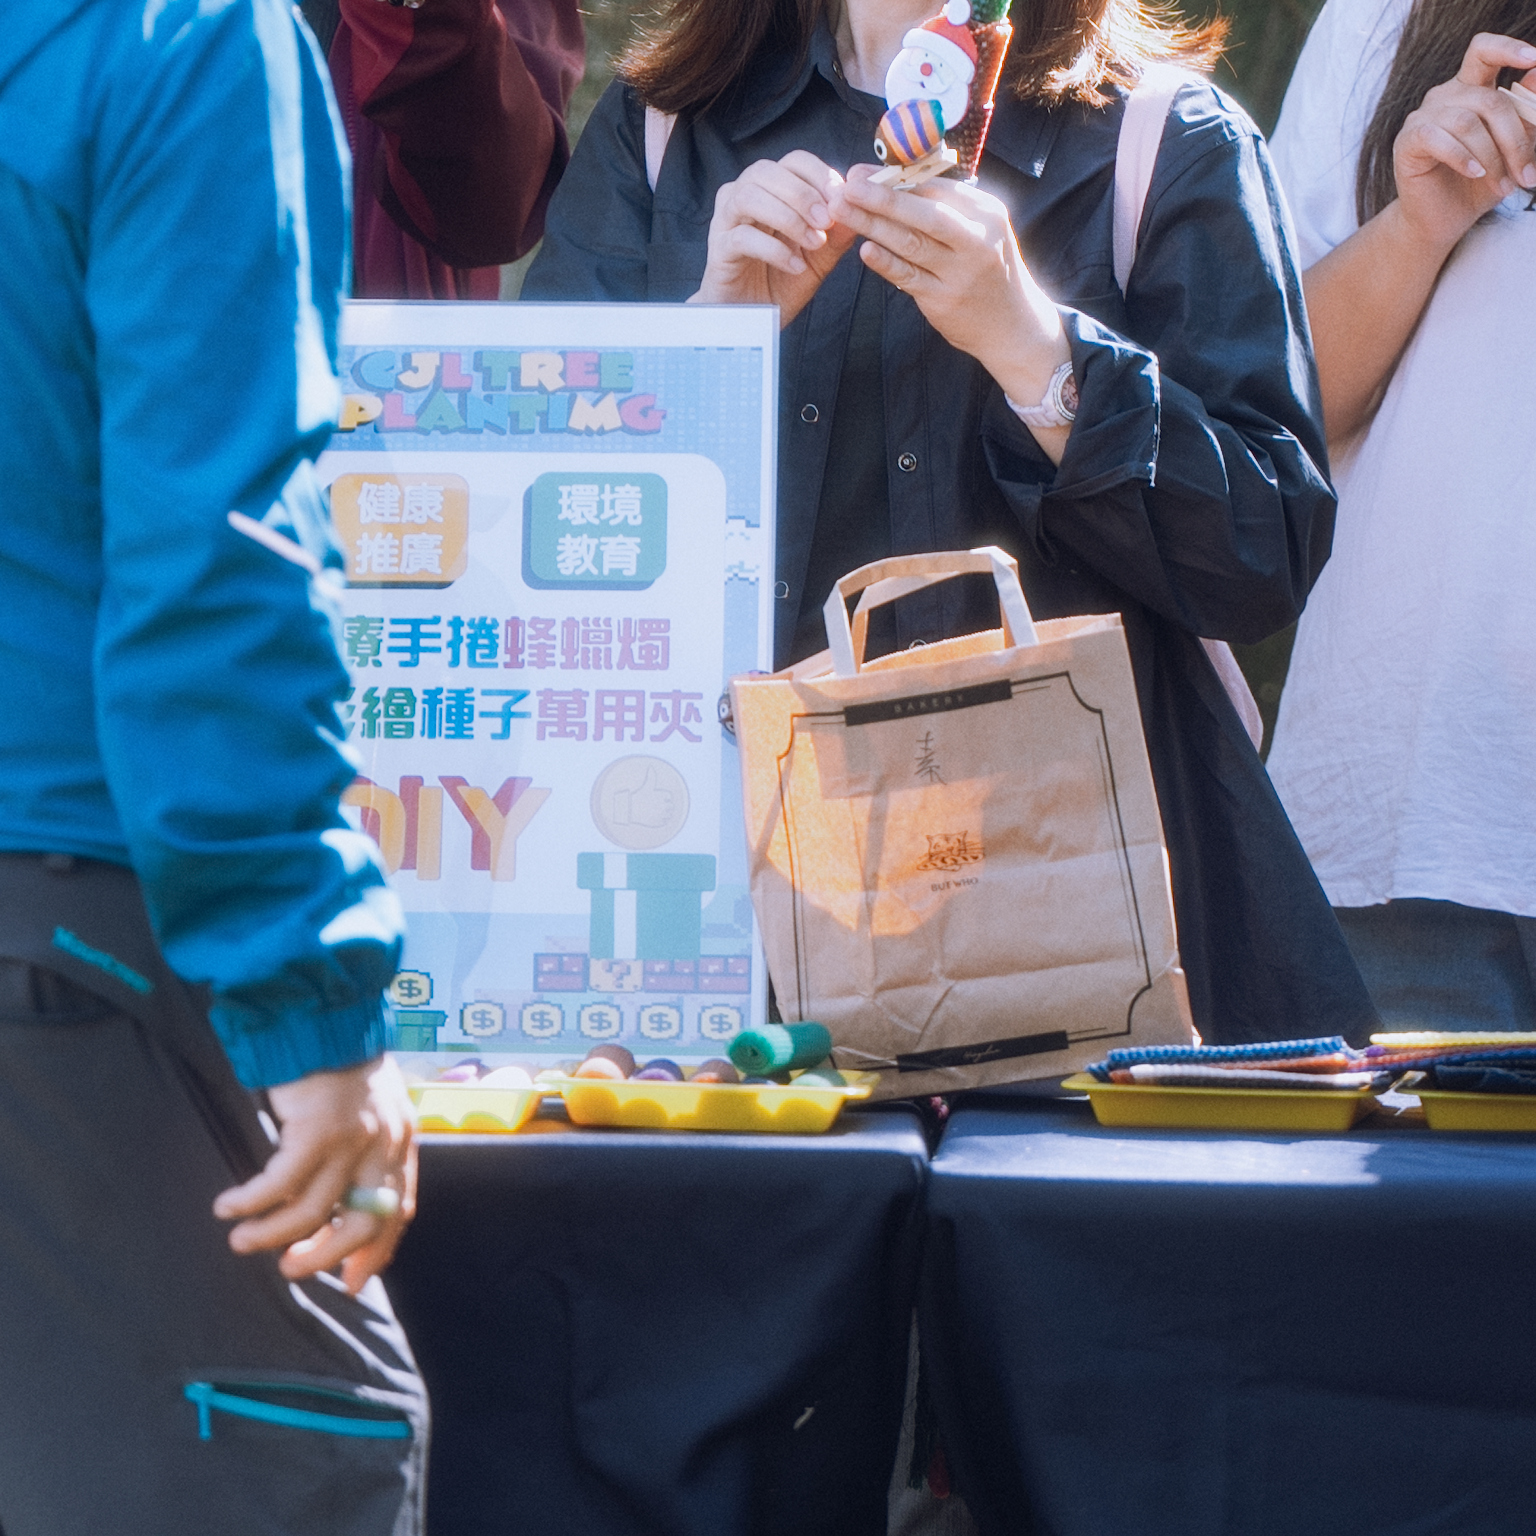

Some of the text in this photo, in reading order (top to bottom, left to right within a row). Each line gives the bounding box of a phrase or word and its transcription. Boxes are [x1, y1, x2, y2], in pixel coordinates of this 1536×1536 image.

[474, 350, 634, 393] TREE
[357, 481, 444, 524] 健康
[557, 483, 643, 525] 環境
[355, 531, 444, 575] 推廣
[556, 533, 641, 576] 教育
